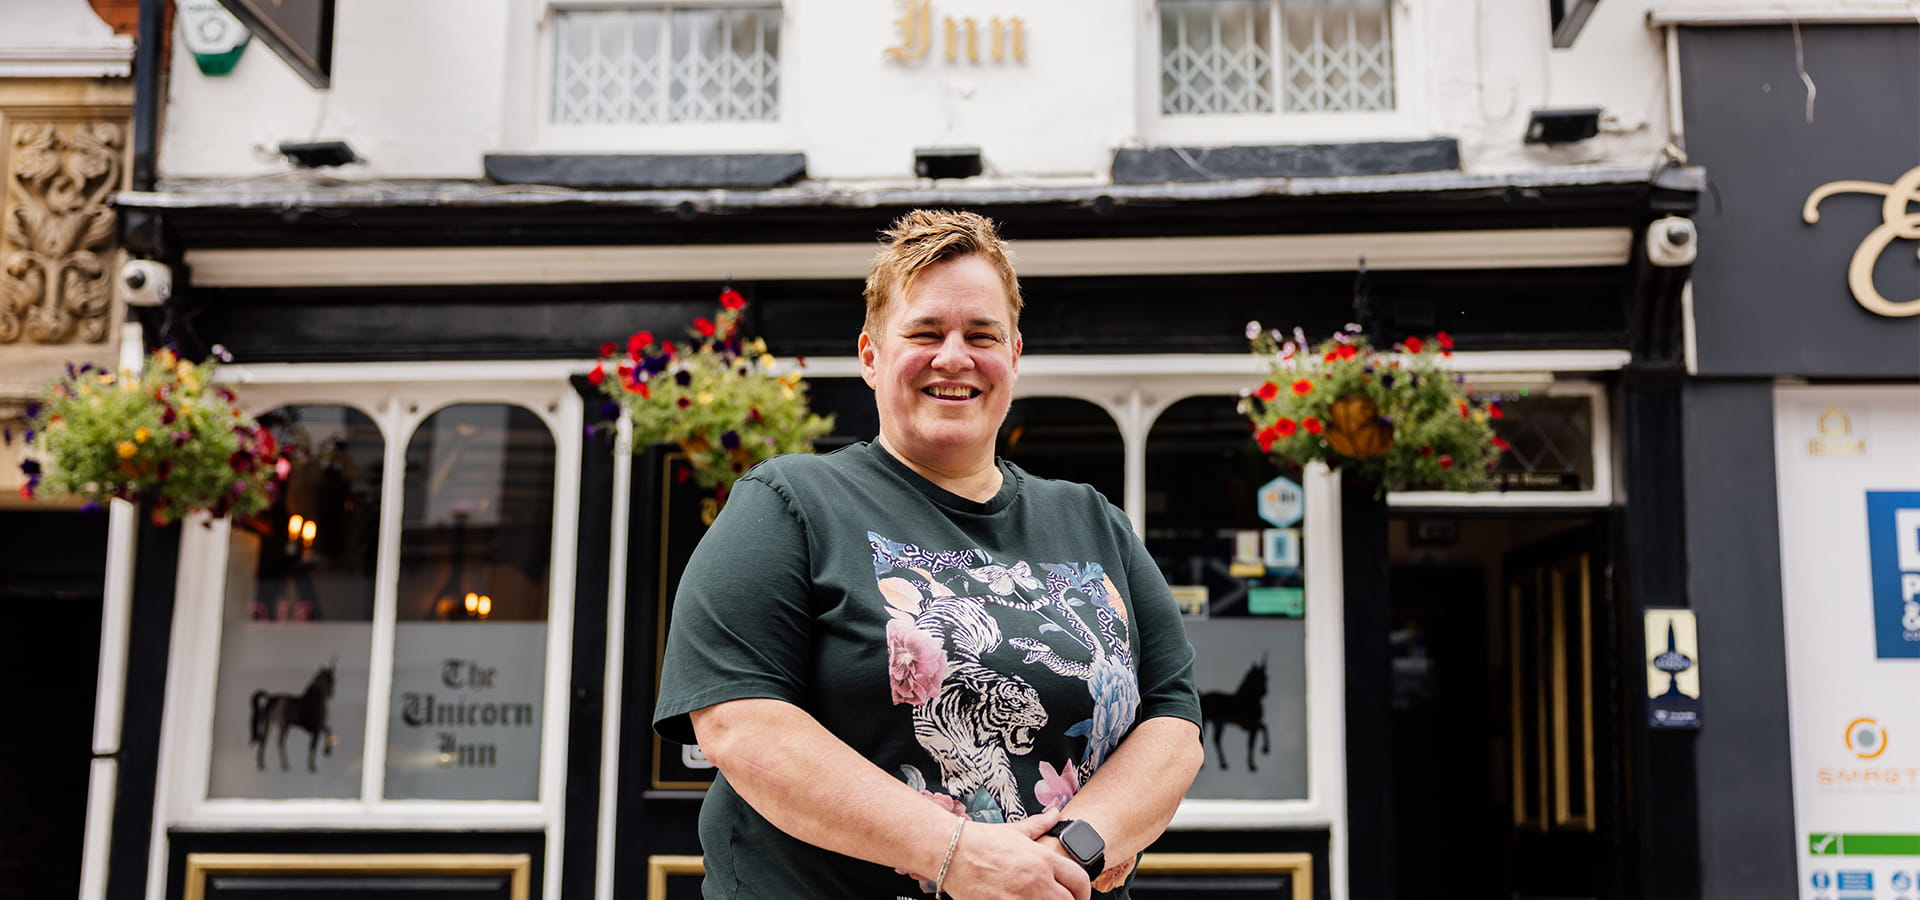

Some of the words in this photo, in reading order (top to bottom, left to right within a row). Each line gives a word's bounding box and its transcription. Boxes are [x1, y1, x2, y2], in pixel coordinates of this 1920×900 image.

[878, 0, 1025, 61] Inn
[442, 658, 497, 689] The
[402, 692, 533, 728] Unicorn
[438, 732, 497, 768] Inn
